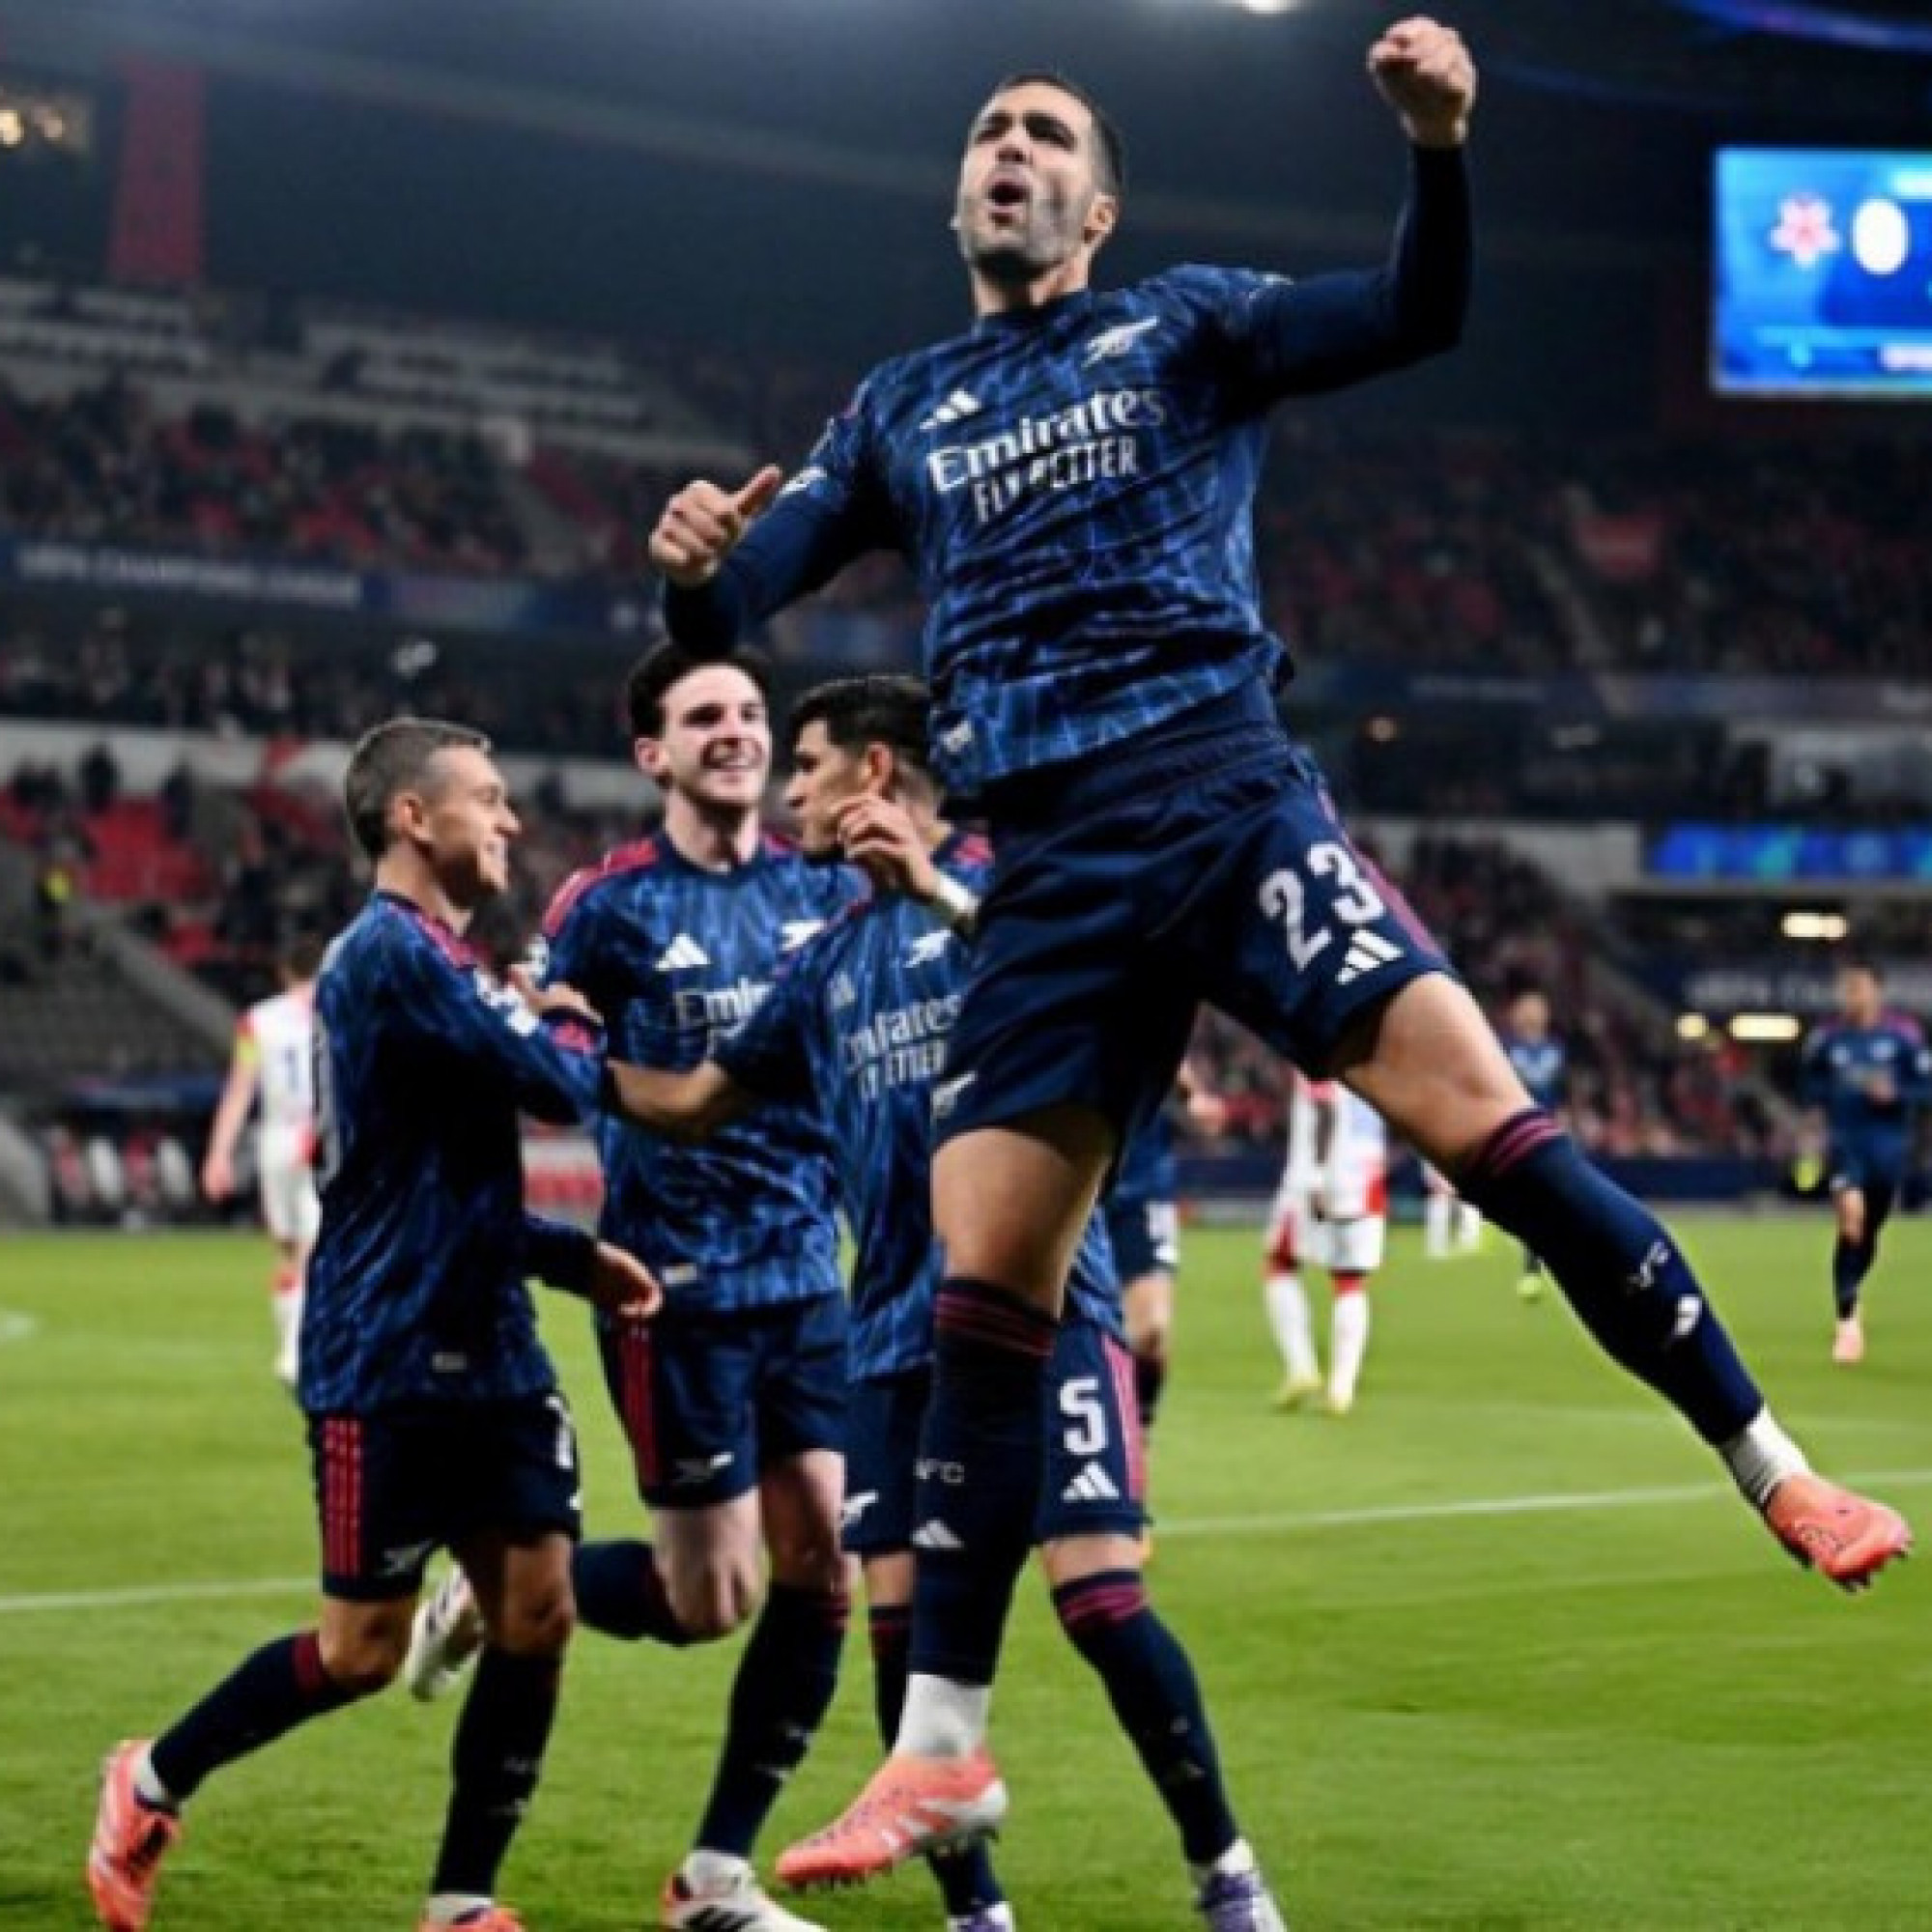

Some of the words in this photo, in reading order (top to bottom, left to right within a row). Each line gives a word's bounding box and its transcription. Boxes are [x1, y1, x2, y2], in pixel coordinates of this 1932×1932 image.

[926, 388, 1167, 495] Emirates
[1259, 839, 1387, 973] 23
[1057, 1376, 1109, 1456] 5
